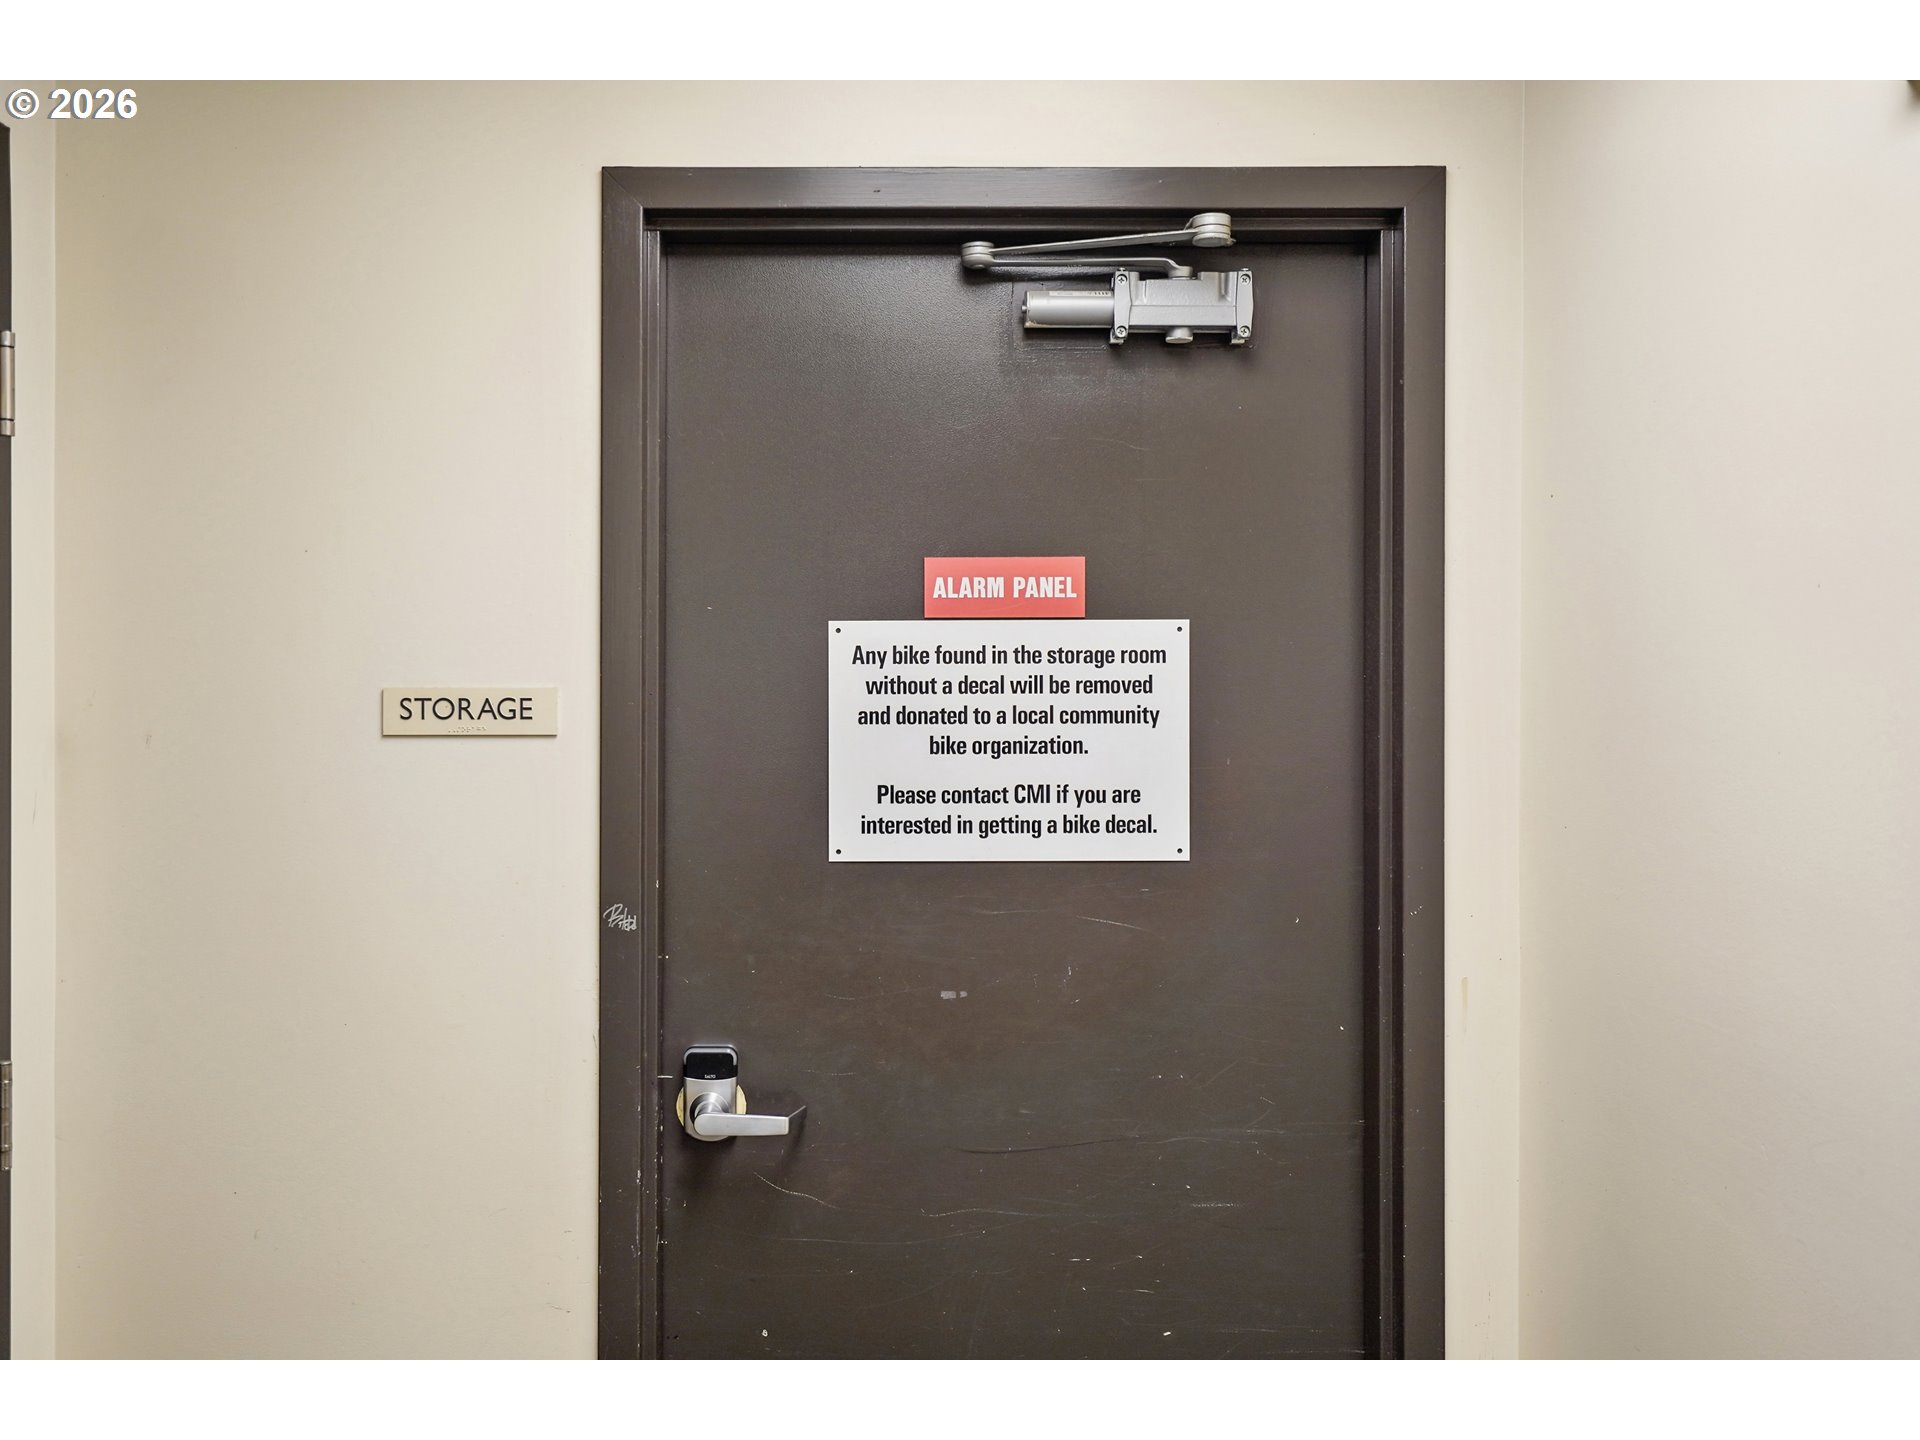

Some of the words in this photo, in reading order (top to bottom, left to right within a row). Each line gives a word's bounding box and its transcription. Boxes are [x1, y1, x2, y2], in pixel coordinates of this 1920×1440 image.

[932, 576, 1005, 599] ALARM
[1013, 576, 1078, 598] PANEL
[851, 645, 888, 670] Any
[892, 644, 930, 665] bike
[934, 644, 987, 665] found
[991, 644, 1008, 665] in
[1012, 644, 1043, 665] the
[1046, 647, 1116, 669] storage
[1120, 649, 1167, 664] room
[865, 675, 938, 695] without
[942, 680, 953, 695] a
[958, 674, 1005, 695] decal
[1009, 674, 1044, 695] will
[1049, 674, 1071, 695] be
[1075, 674, 1153, 695] removed
[399, 697, 533, 721] STORAGE
[857, 705, 891, 726] and
[895, 704, 968, 725] donated
[972, 707, 991, 725] to
[996, 710, 1007, 725] a
[1012, 704, 1054, 725] local
[1059, 704, 1160, 729] community
[929, 735, 967, 755] bike
[971, 734, 1089, 760] organization.
[877, 784, 937, 805] Please
[941, 786, 1010, 805] contact
[1014, 783, 1051, 804] CMI
[1056, 783, 1070, 804] if
[1073, 789, 1107, 809] you
[1111, 789, 1141, 804] are
[861, 814, 952, 835] interested
[957, 814, 973, 834] in
[978, 814, 1042, 839] getting
[1046, 819, 1058, 834] a
[1062, 814, 1101, 834] bike
[1105, 813, 1158, 834] decal.
